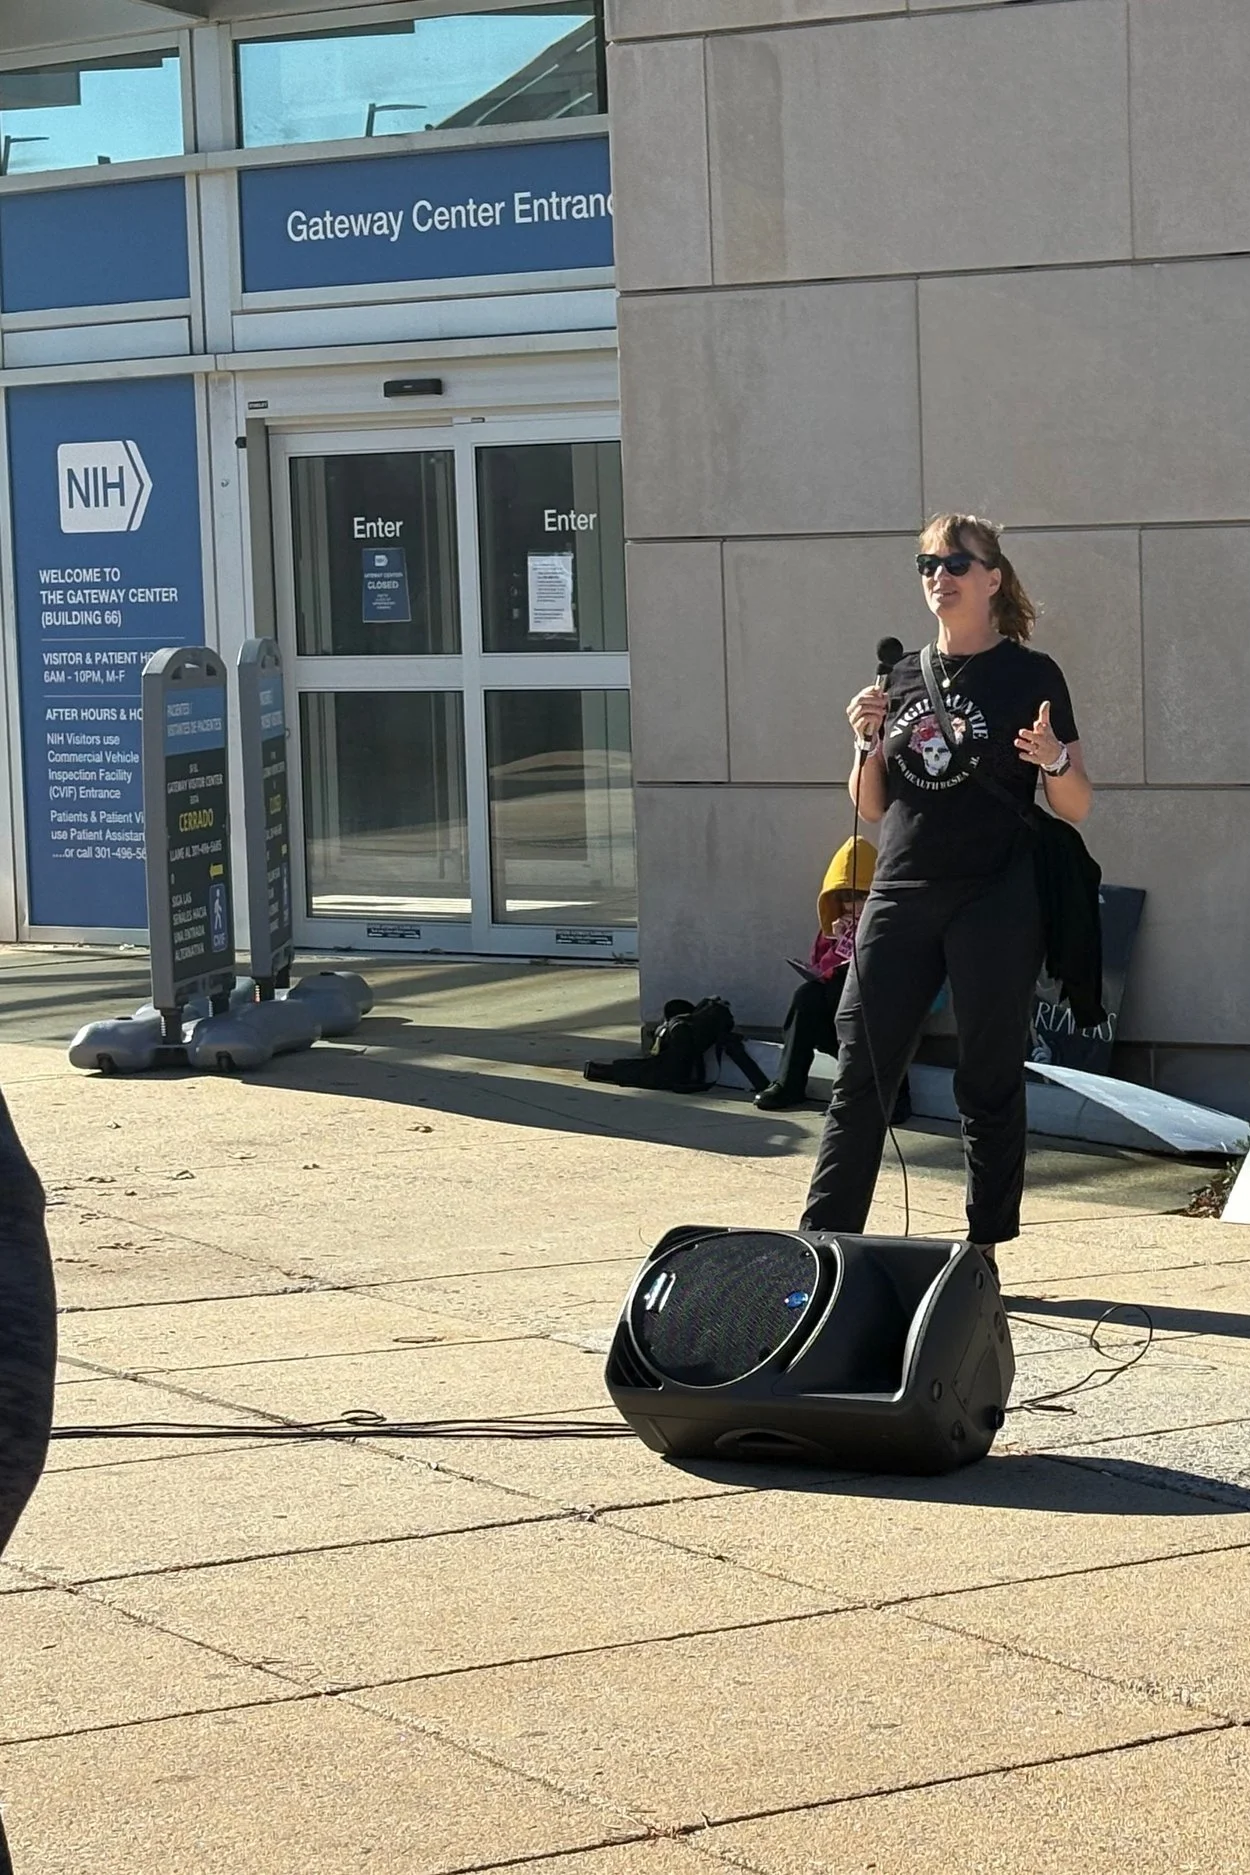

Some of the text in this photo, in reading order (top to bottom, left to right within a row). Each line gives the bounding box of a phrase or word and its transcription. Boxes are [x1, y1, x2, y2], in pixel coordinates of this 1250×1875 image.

[287, 189, 614, 242] Gateway Center Entranc
[66, 465, 126, 510] NIH
[353, 517, 403, 538] Enter
[544, 509, 597, 532] Enter
[39, 567, 121, 584] WELCOME TO
[367, 580, 399, 590] CLOSED
[40, 587, 178, 605] THE GATEWAY CENTER
[41, 611, 122, 628] (BUILDING 66)
[43, 652, 138, 665] VISITOR & PATIENT
[44, 670, 65, 683] 6AM
[74, 669, 104, 684] 10PM,
[106, 670, 126, 683] M-F
[46, 708, 144, 721] AFTER HOURS & HO
[47, 732, 120, 745] NIH Visitors use
[48, 750, 140, 763] Commercial Vehicle
[48, 768, 132, 784] Inspection Facility
[903, 769, 940, 791] HEALTH
[49, 785, 121, 800] (CVIF) Entrance
[50, 810, 144, 823] Patients & Patient Vi
[179, 808, 214, 832] CERRADO
[51, 828, 145, 841] use Patient Assistan
[76, 846, 147, 860] call 301-496-56
